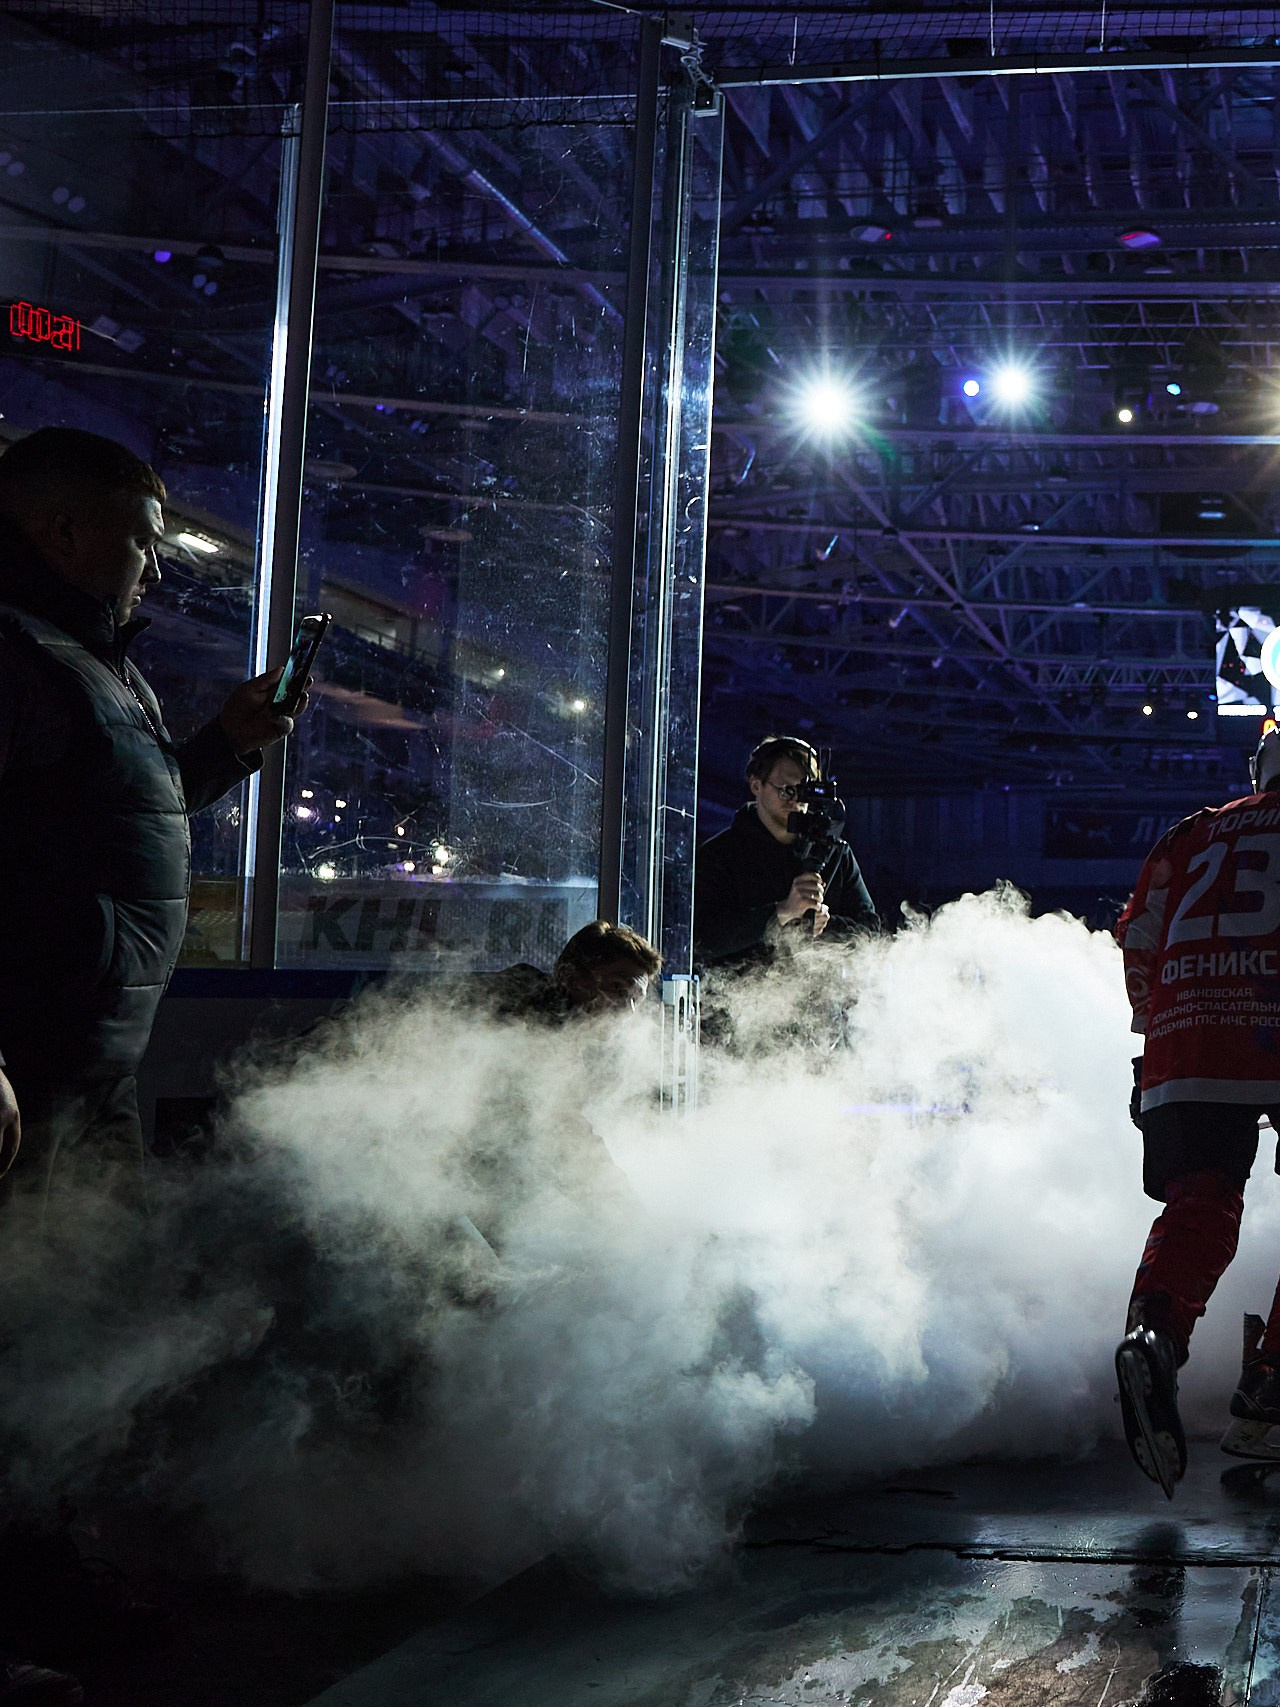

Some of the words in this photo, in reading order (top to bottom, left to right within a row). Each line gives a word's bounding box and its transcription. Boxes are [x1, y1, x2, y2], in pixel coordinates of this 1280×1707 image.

[1161, 949, 1279, 985] ФЕНИКС
[1176, 987, 1253, 1003] ИВАНОВСКАЯ
[1148, 1017, 1193, 1041] АКАДЕМИЯ
[1195, 1014, 1217, 1026] ГПС
[1220, 1015, 1247, 1027] МЧС
